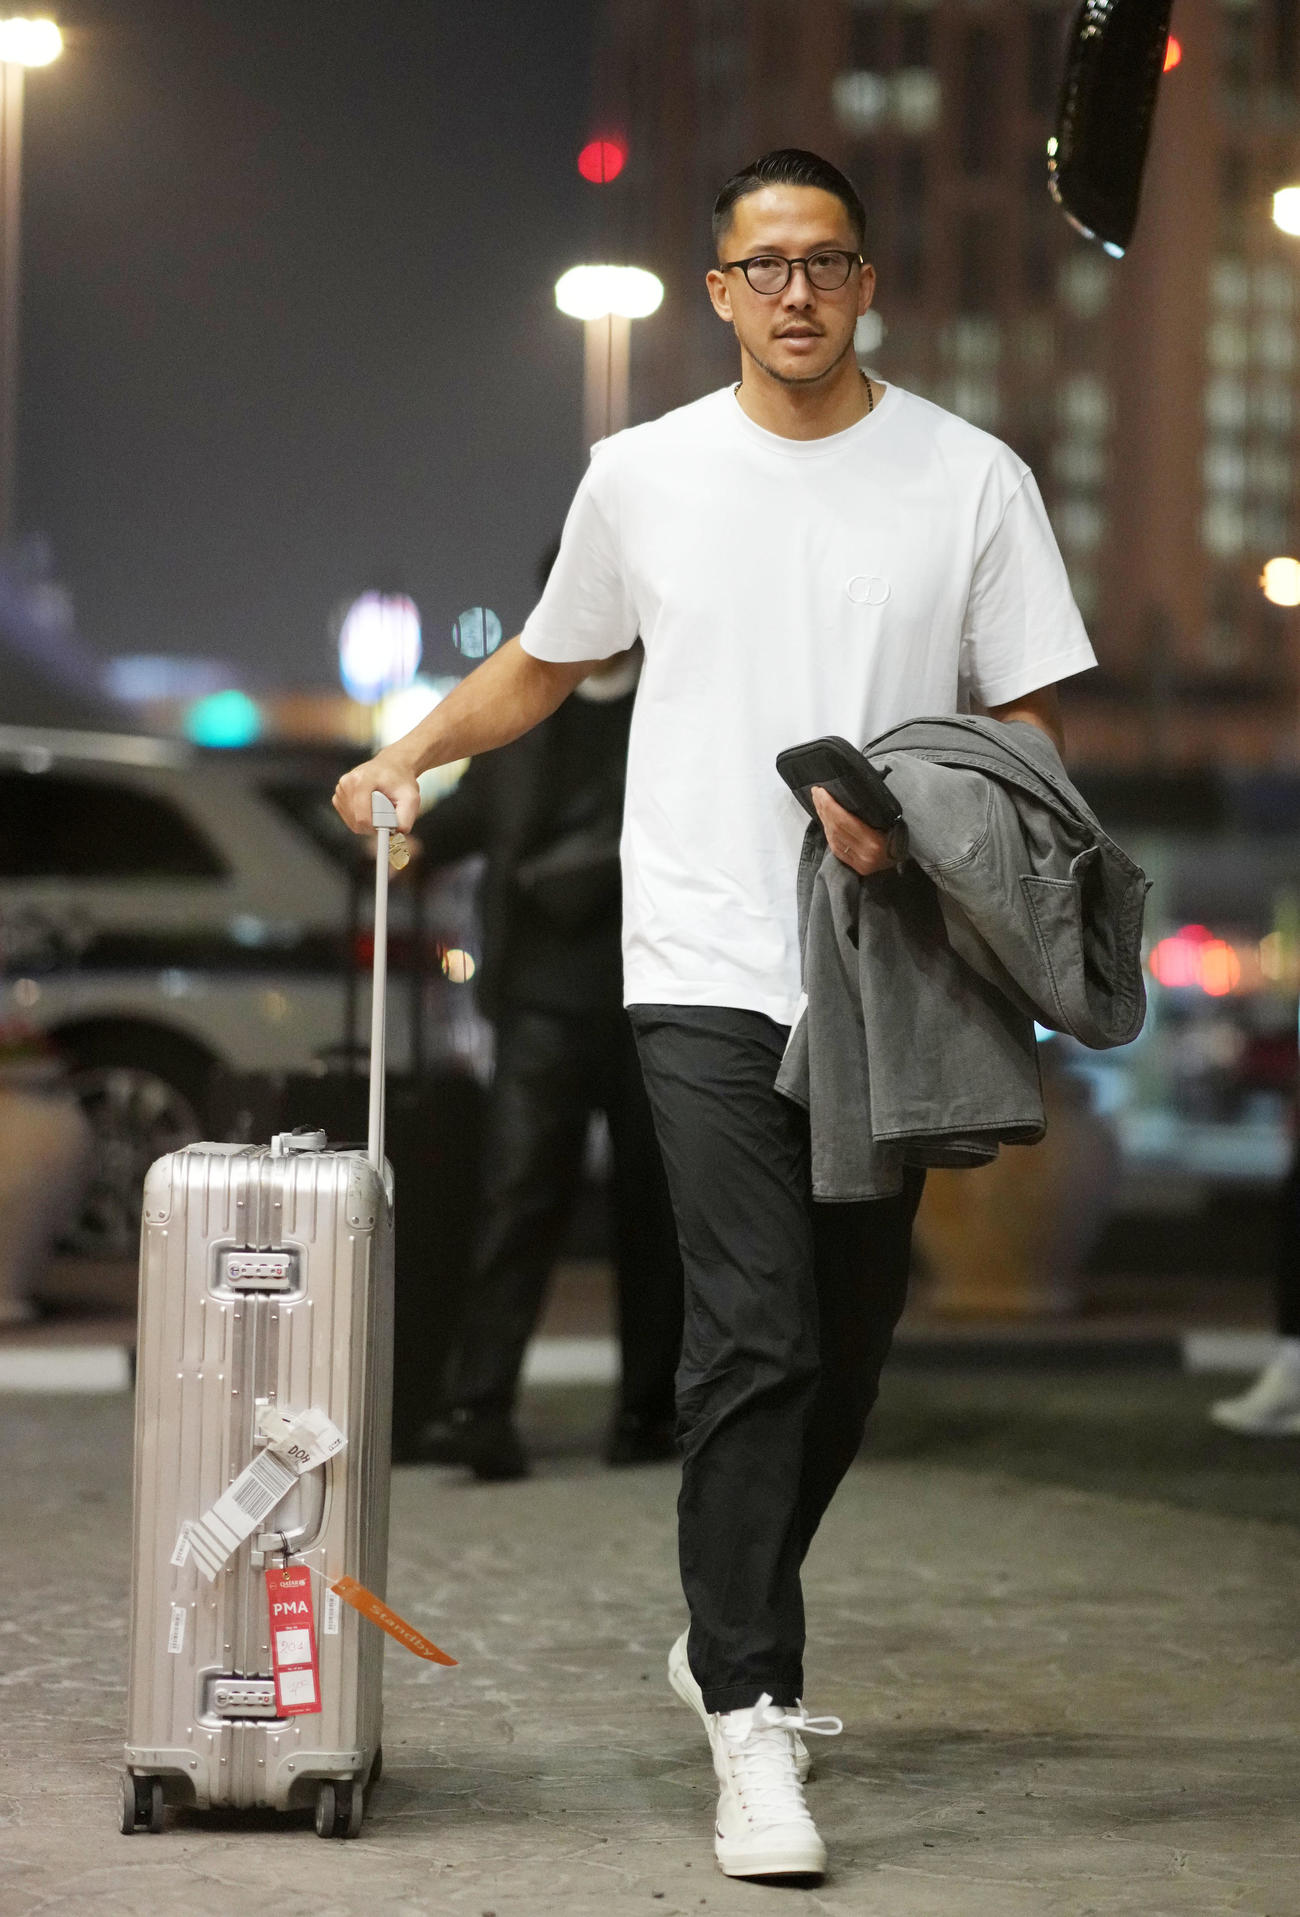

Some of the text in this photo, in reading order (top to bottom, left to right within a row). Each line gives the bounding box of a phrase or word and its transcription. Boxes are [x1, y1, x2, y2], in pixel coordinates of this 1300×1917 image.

[288, 1445, 311, 1464] DOH
[273, 1600, 309, 1616] PMA
[369, 1604, 434, 1656] Standby
